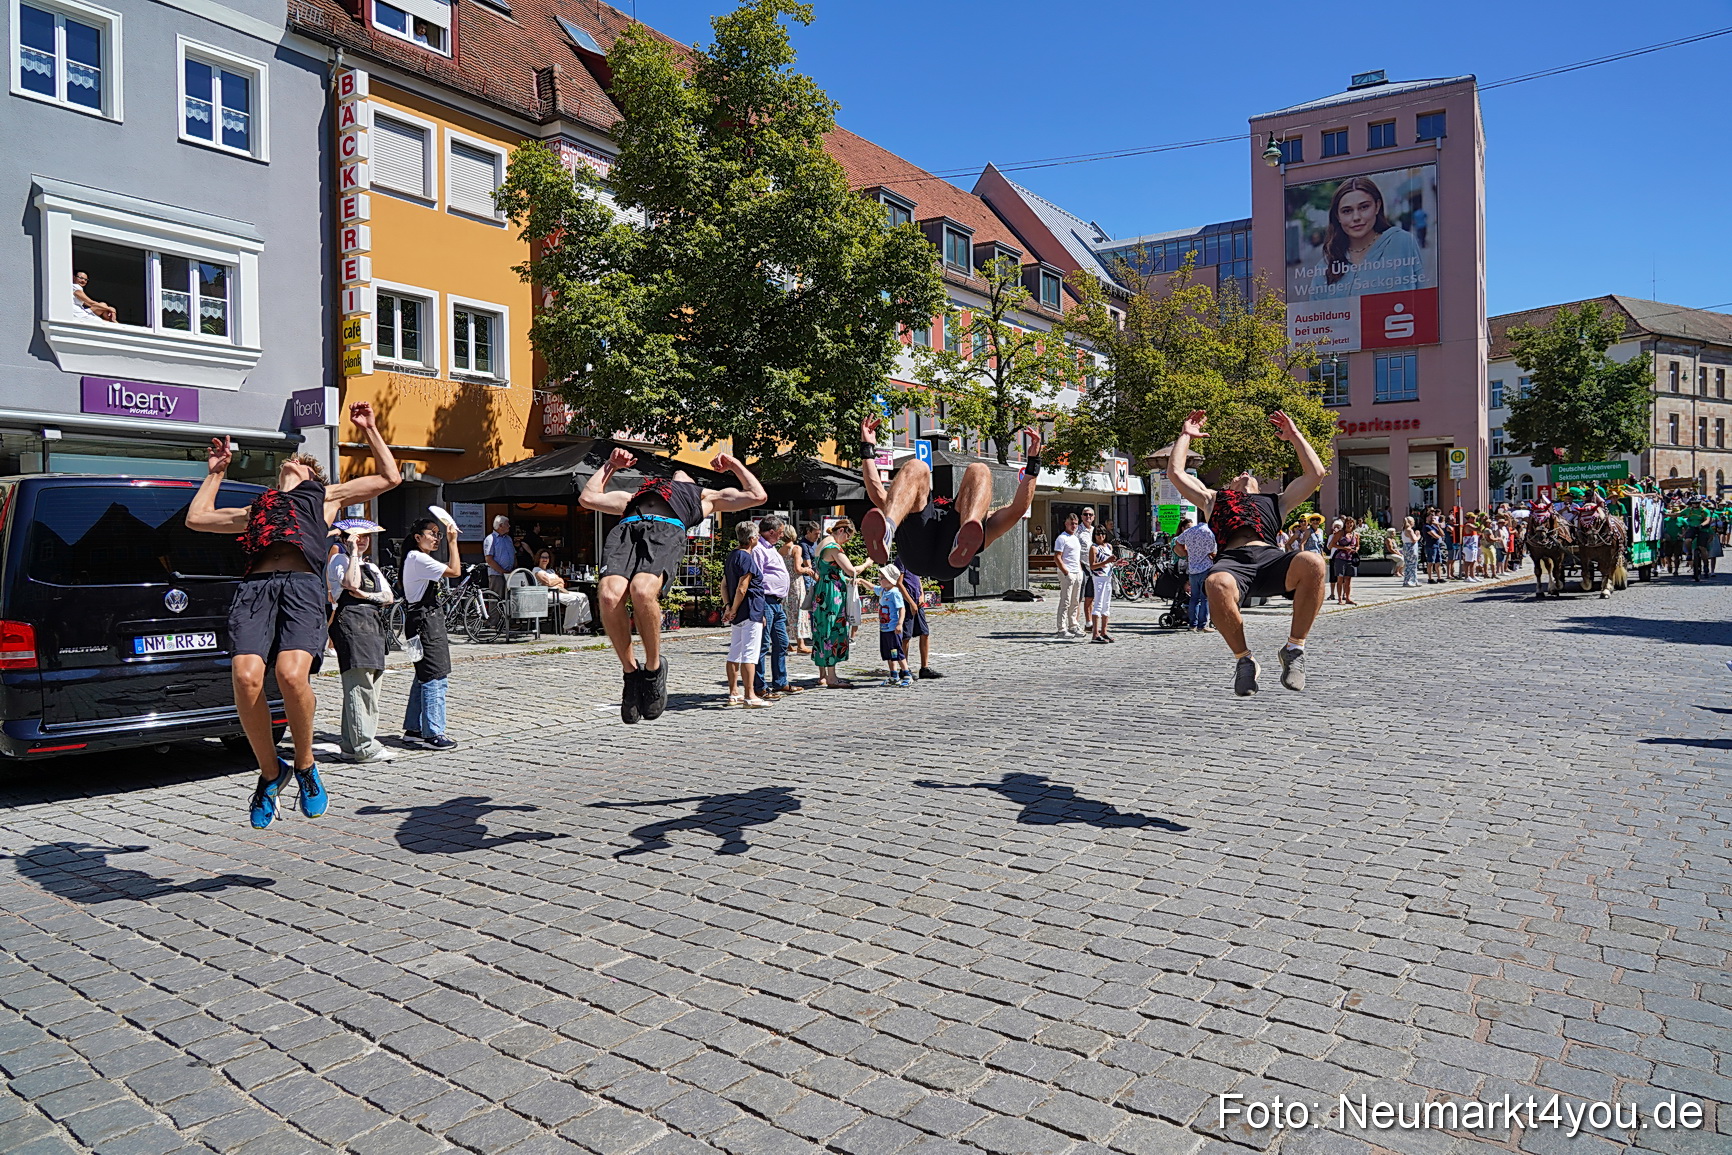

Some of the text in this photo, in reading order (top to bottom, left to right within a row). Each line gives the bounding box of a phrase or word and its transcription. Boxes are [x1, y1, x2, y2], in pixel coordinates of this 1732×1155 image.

[341, 73, 357, 311] BÄCKEREI
[1294, 256, 1421, 279] Mehr Überholspur.
[1294, 273, 1431, 297] Weniger Sackgasse.
[1294, 310, 1351, 323] Ausbildung
[343, 321, 361, 340] café
[1295, 326, 1333, 337] bei uns.
[1331, 337, 1350, 346] jetzt!
[343, 353, 362, 372] plank
[107, 383, 179, 415] liberty
[293, 399, 324, 418] liberty
[129, 407, 159, 416] woman
[1338, 417, 1421, 436] Sparkasse
[918, 444, 929, 461] P
[1558, 462, 1622, 473] Deutscher Alpenverein
[1558, 471, 1609, 481] Sektion Neumarkt
[144, 632, 216, 652] NM RR 32
